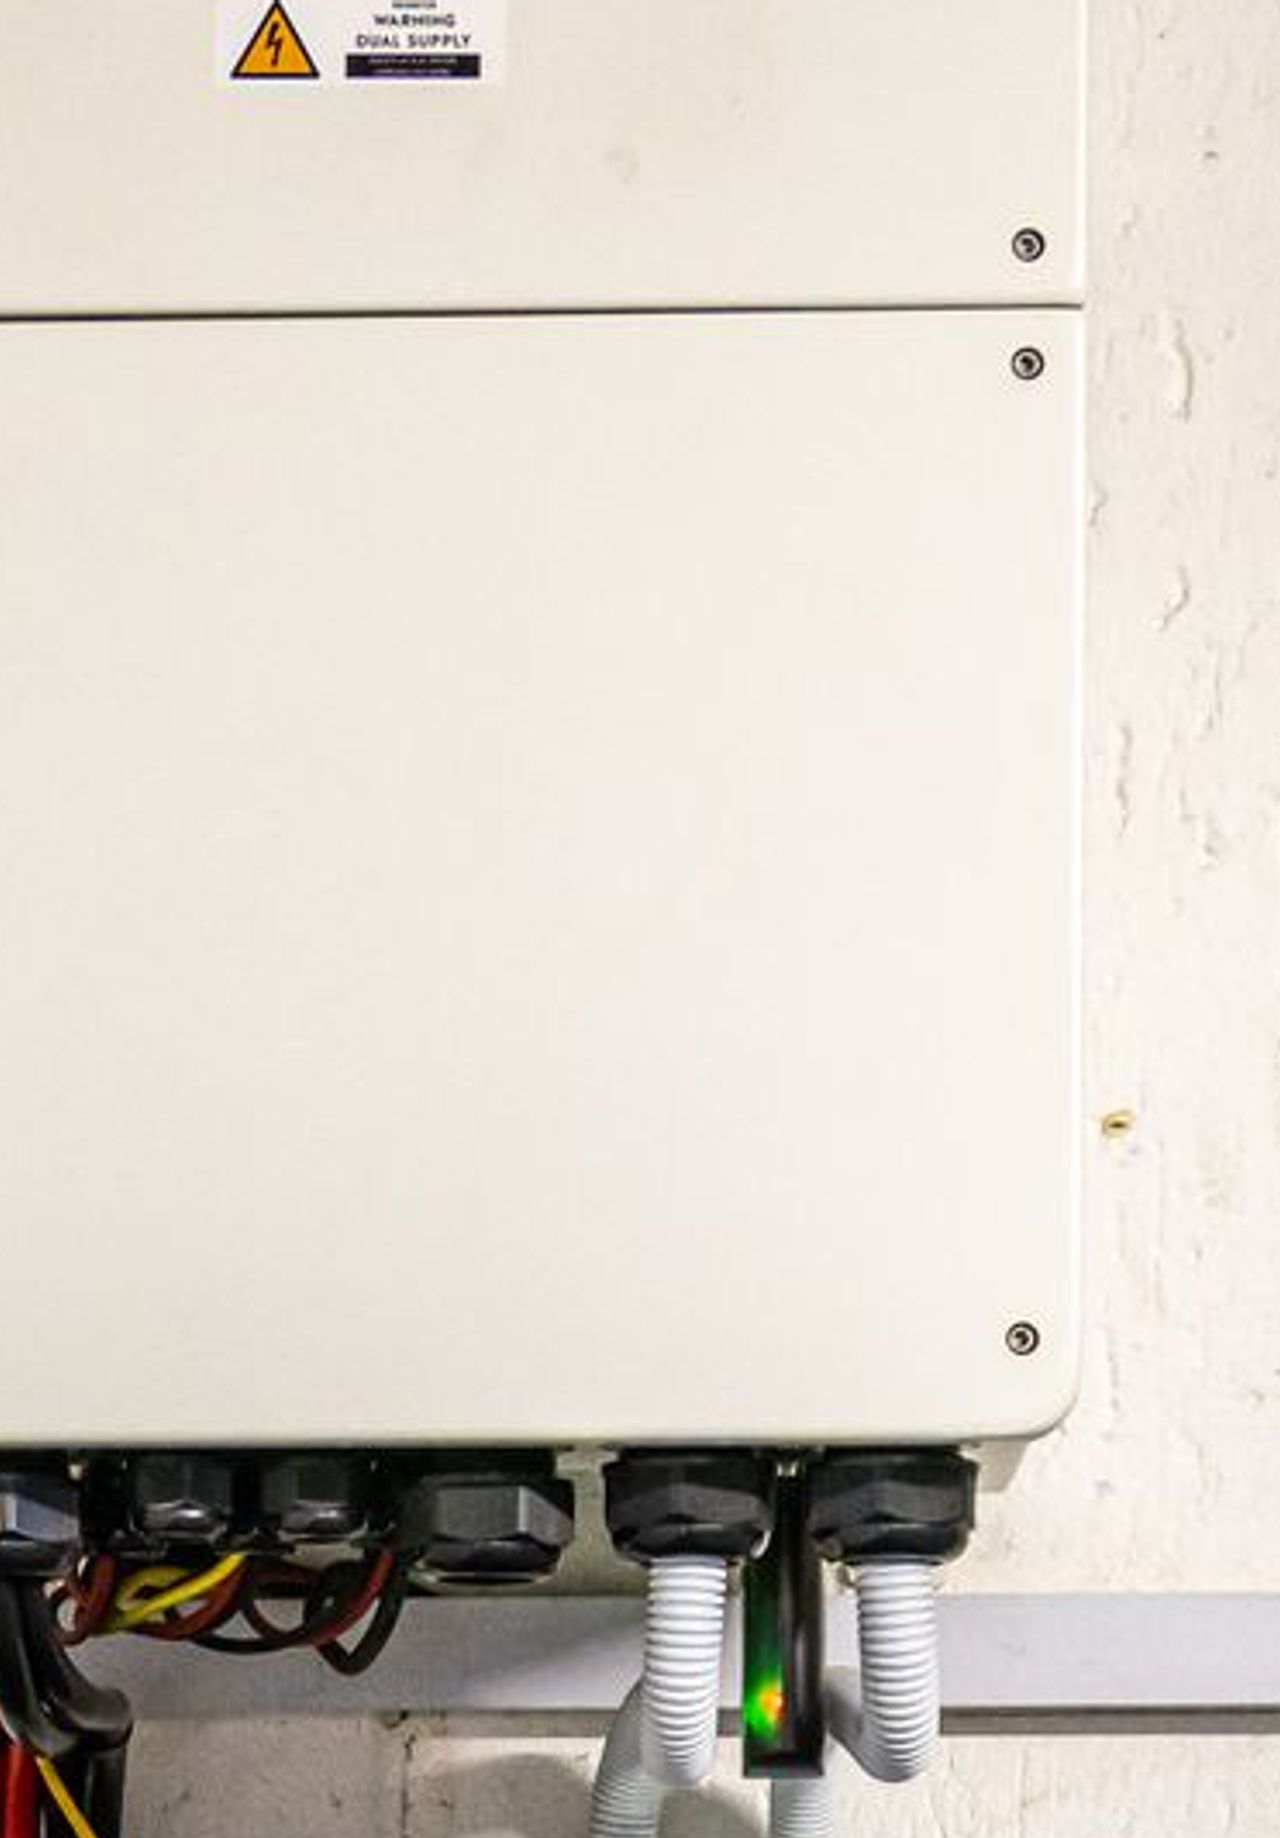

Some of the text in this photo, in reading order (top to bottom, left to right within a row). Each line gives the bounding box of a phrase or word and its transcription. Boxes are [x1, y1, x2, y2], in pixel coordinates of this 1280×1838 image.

[373, 14, 456, 28] WARNING
[356, 34, 471, 48] DUAL SUPPLY
